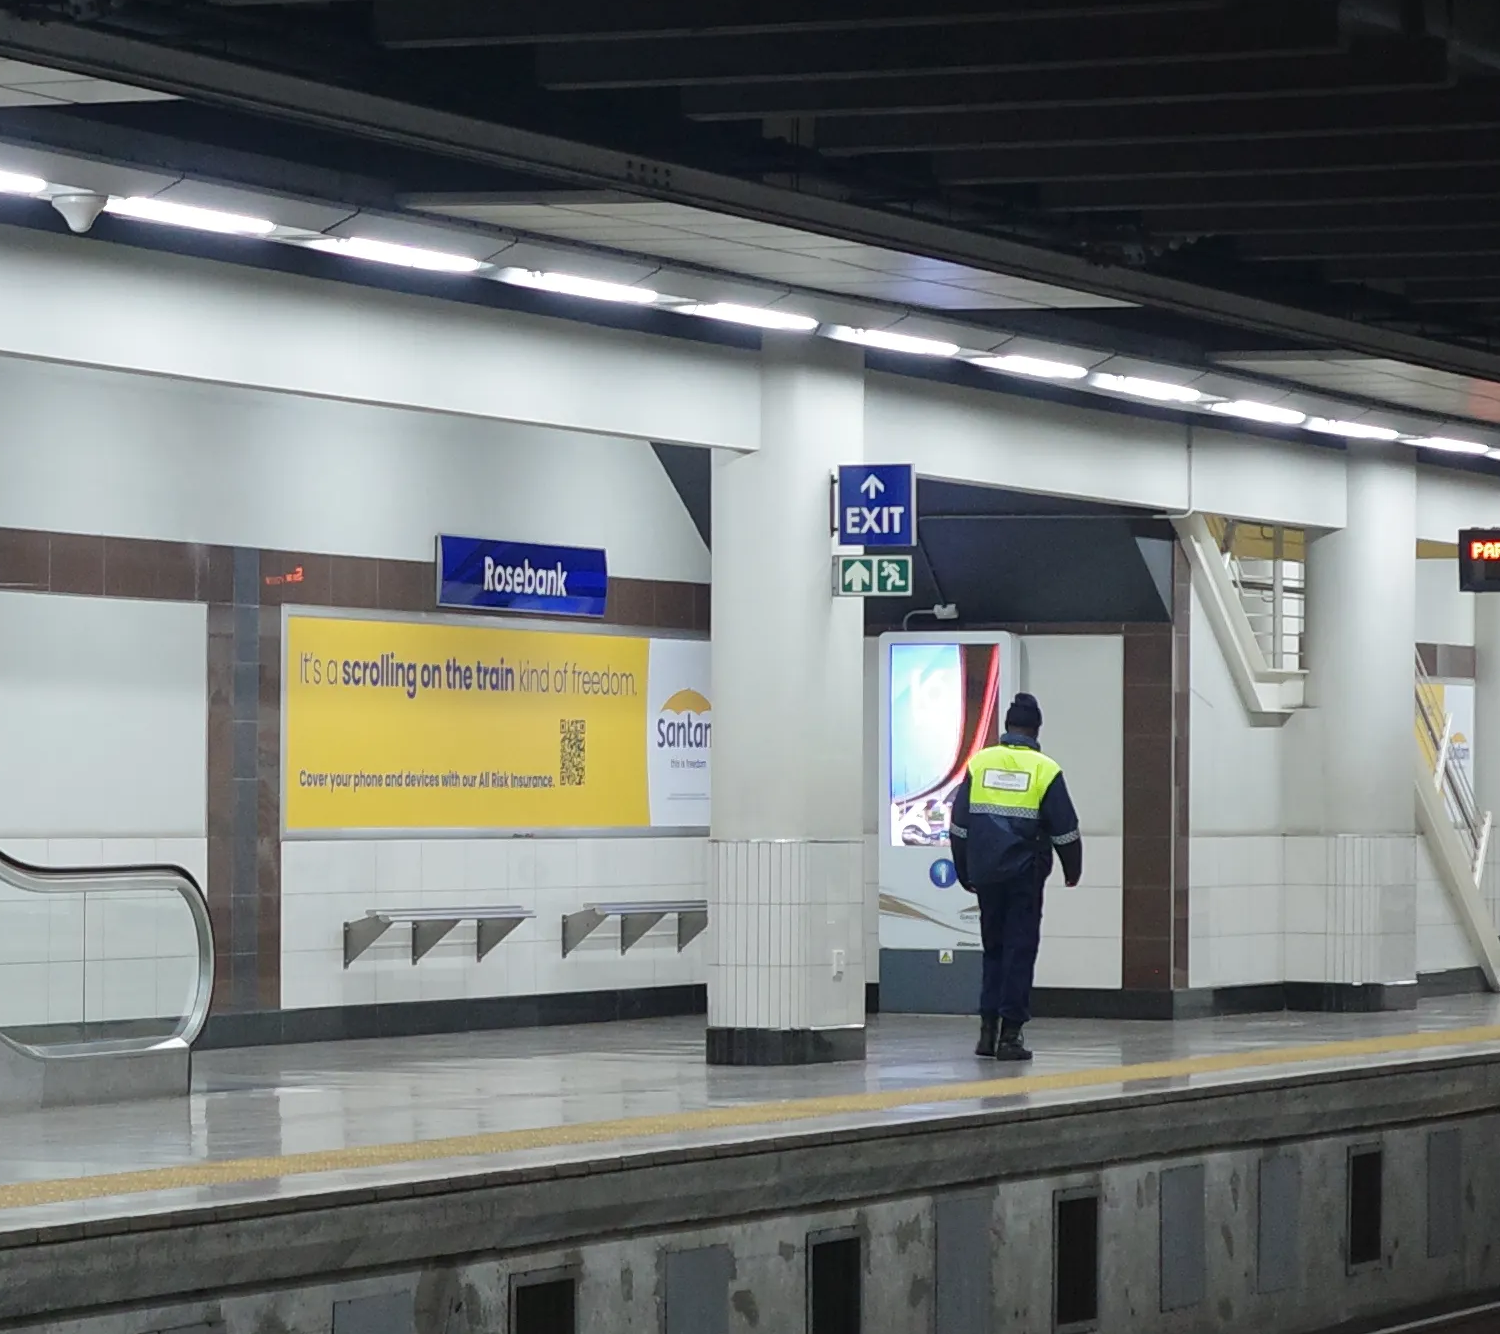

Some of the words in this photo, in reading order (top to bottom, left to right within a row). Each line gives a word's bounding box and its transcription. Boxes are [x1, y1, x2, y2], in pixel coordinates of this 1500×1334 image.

[846, 506, 904, 534] EXIT
[483, 555, 568, 598] Rosebank
[300, 652, 322, 685] It’s
[327, 659, 338, 685] a
[342, 652, 417, 699] scrolling
[421, 663, 442, 689] on
[446, 657, 473, 690] the
[476, 657, 515, 692] train
[519, 659, 549, 694] kind
[554, 662, 568, 694] of
[572, 662, 637, 696] freedom.
[300, 769, 328, 787] Cover
[330, 772, 351, 793] your
[354, 770, 383, 792] phone
[385, 771, 402, 787] and
[405, 770, 440, 788] devices
[442, 770, 460, 788] with
[462, 774, 476, 788] our
[479, 771, 489, 787] All
[492, 771, 509, 788] Risk
[511, 771, 555, 789] Insurance.
